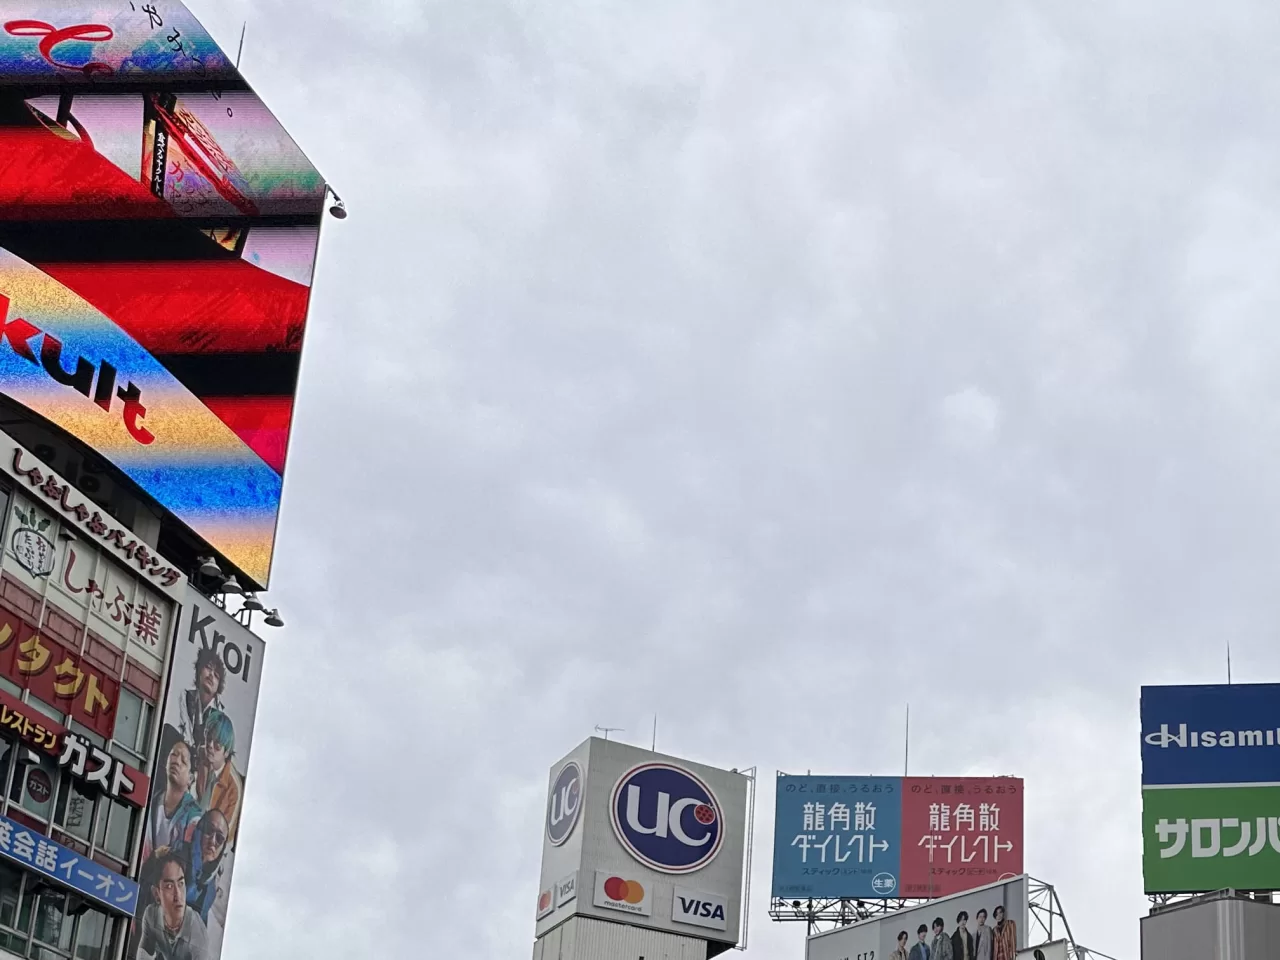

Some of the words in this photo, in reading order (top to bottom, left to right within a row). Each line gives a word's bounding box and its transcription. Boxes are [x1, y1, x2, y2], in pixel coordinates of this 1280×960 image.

[13, 447, 181, 587] しゃぶしゃぶバイキング
[65, 549, 162, 646] しゃぶ葉
[188, 604, 253, 684] Kroi
[1, 704, 57, 750] レストラン
[59, 734, 135, 797] ガスト
[802, 801, 877, 831] 龍角散
[929, 803, 1000, 832] 龍角散
[0, 820, 133, 903] 英会話イーオン
[791, 835, 890, 863] ダイレクト
[917, 835, 1013, 863] ダイレクト
[559, 878, 575, 898] VISA
[873, 878, 895, 889] 生薬
[604, 900, 642, 913] mastercard
[677, 896, 725, 921] VISA
